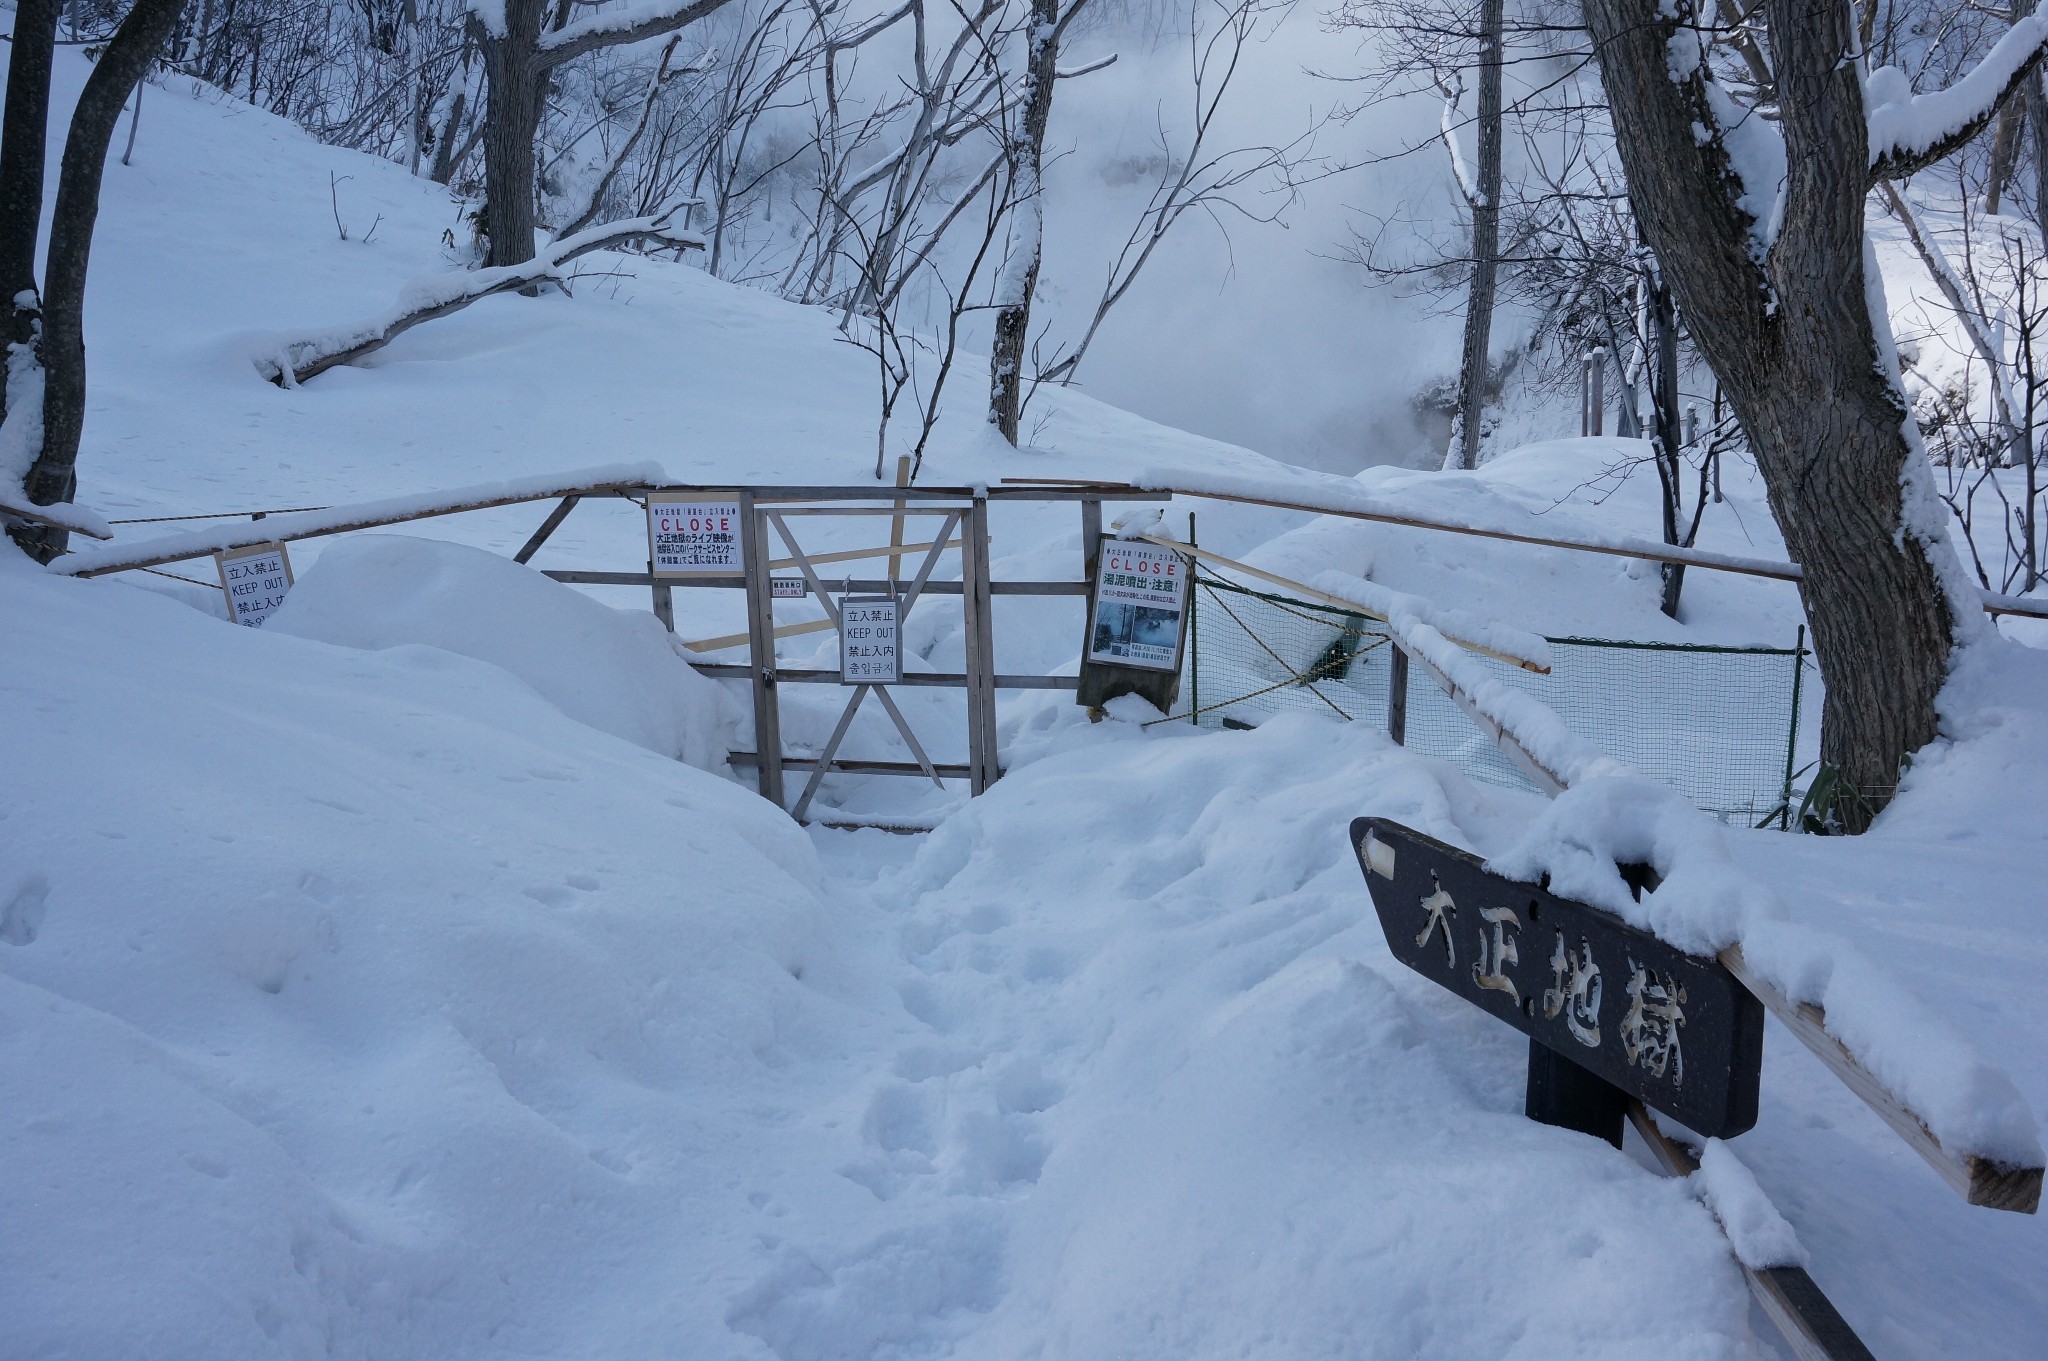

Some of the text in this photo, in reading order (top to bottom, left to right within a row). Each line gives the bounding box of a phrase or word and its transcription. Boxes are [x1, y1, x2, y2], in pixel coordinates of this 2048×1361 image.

[661, 518, 729, 532] CLOSE
[228, 560, 281, 580] 立入禁止
[1110, 557, 1176, 576] CLOSE
[231, 576, 284, 597] KEEP OUT
[847, 610, 894, 622] 立入禁止
[847, 627, 894, 639] KEEP OUT
[848, 645, 894, 658] 禁止入内
[849, 662, 894, 675] 출입금지
